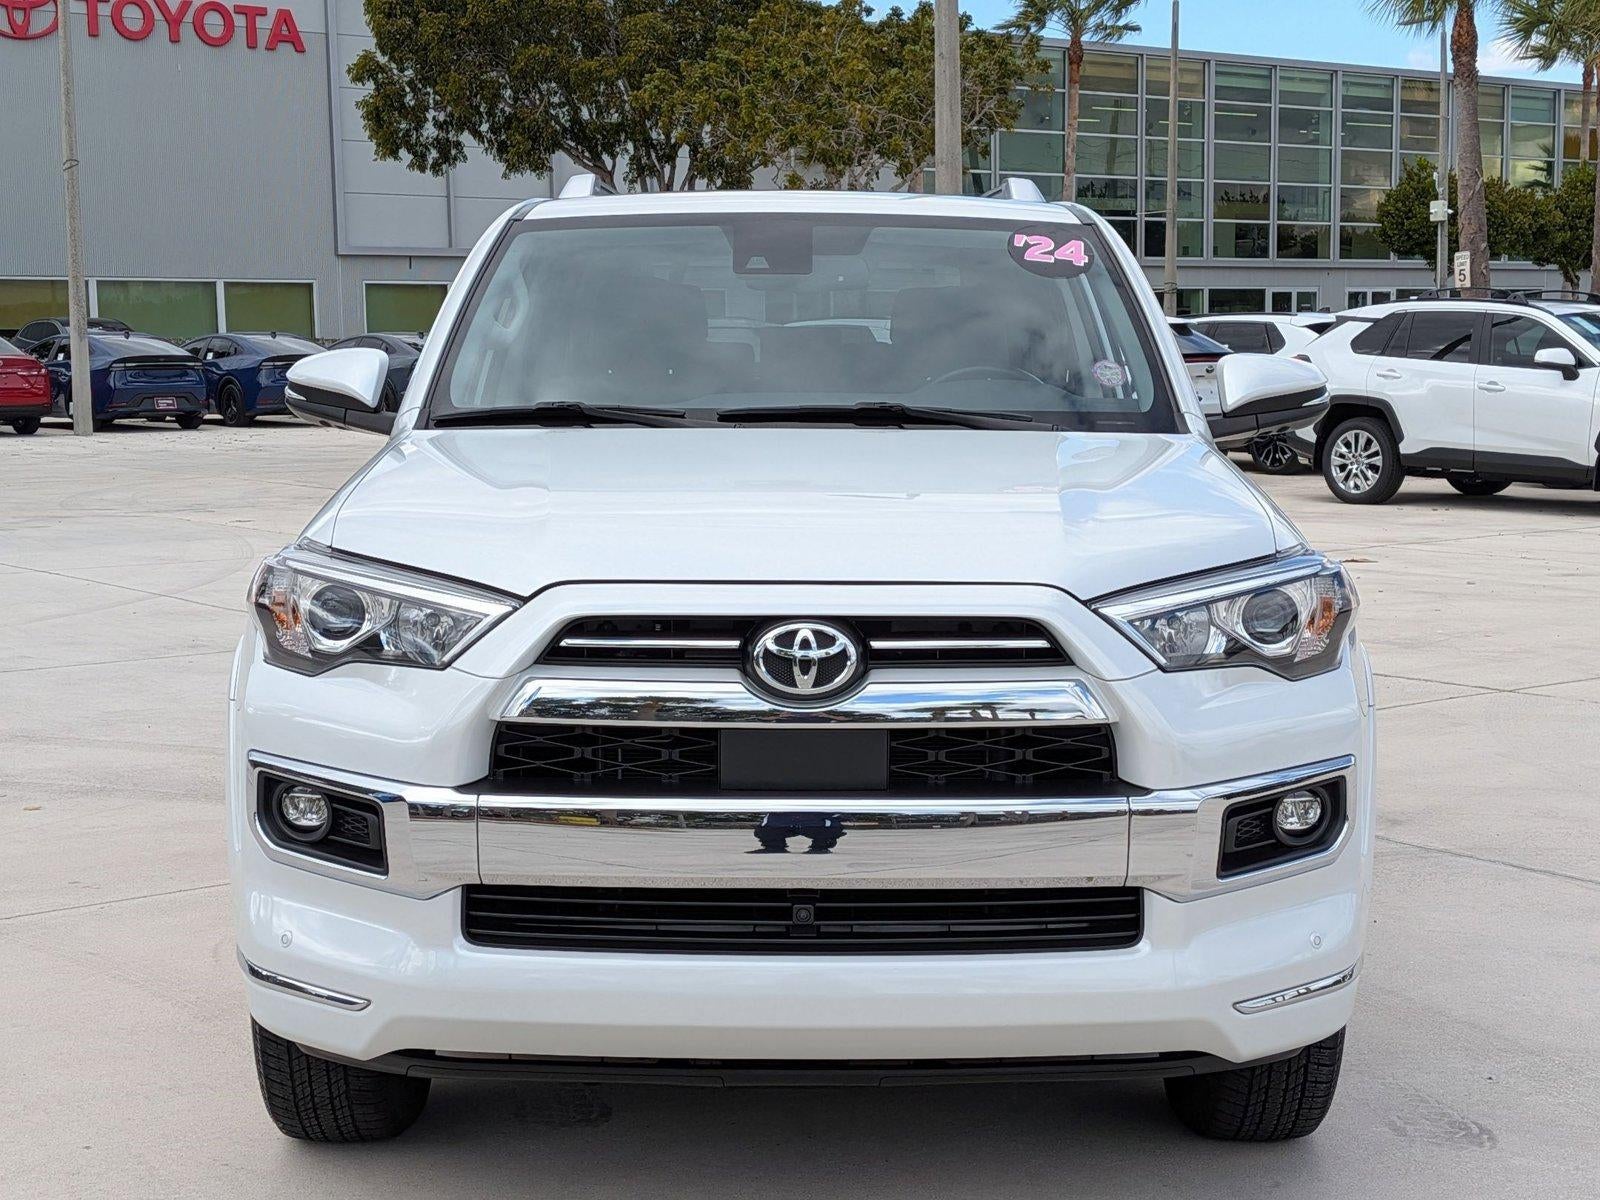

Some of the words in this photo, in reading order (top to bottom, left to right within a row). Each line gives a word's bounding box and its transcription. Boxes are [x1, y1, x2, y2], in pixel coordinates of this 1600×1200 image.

[74, 0, 306, 53] TOYOTA
[1014, 234, 1089, 267] '24
[1458, 268, 1466, 282] 5
